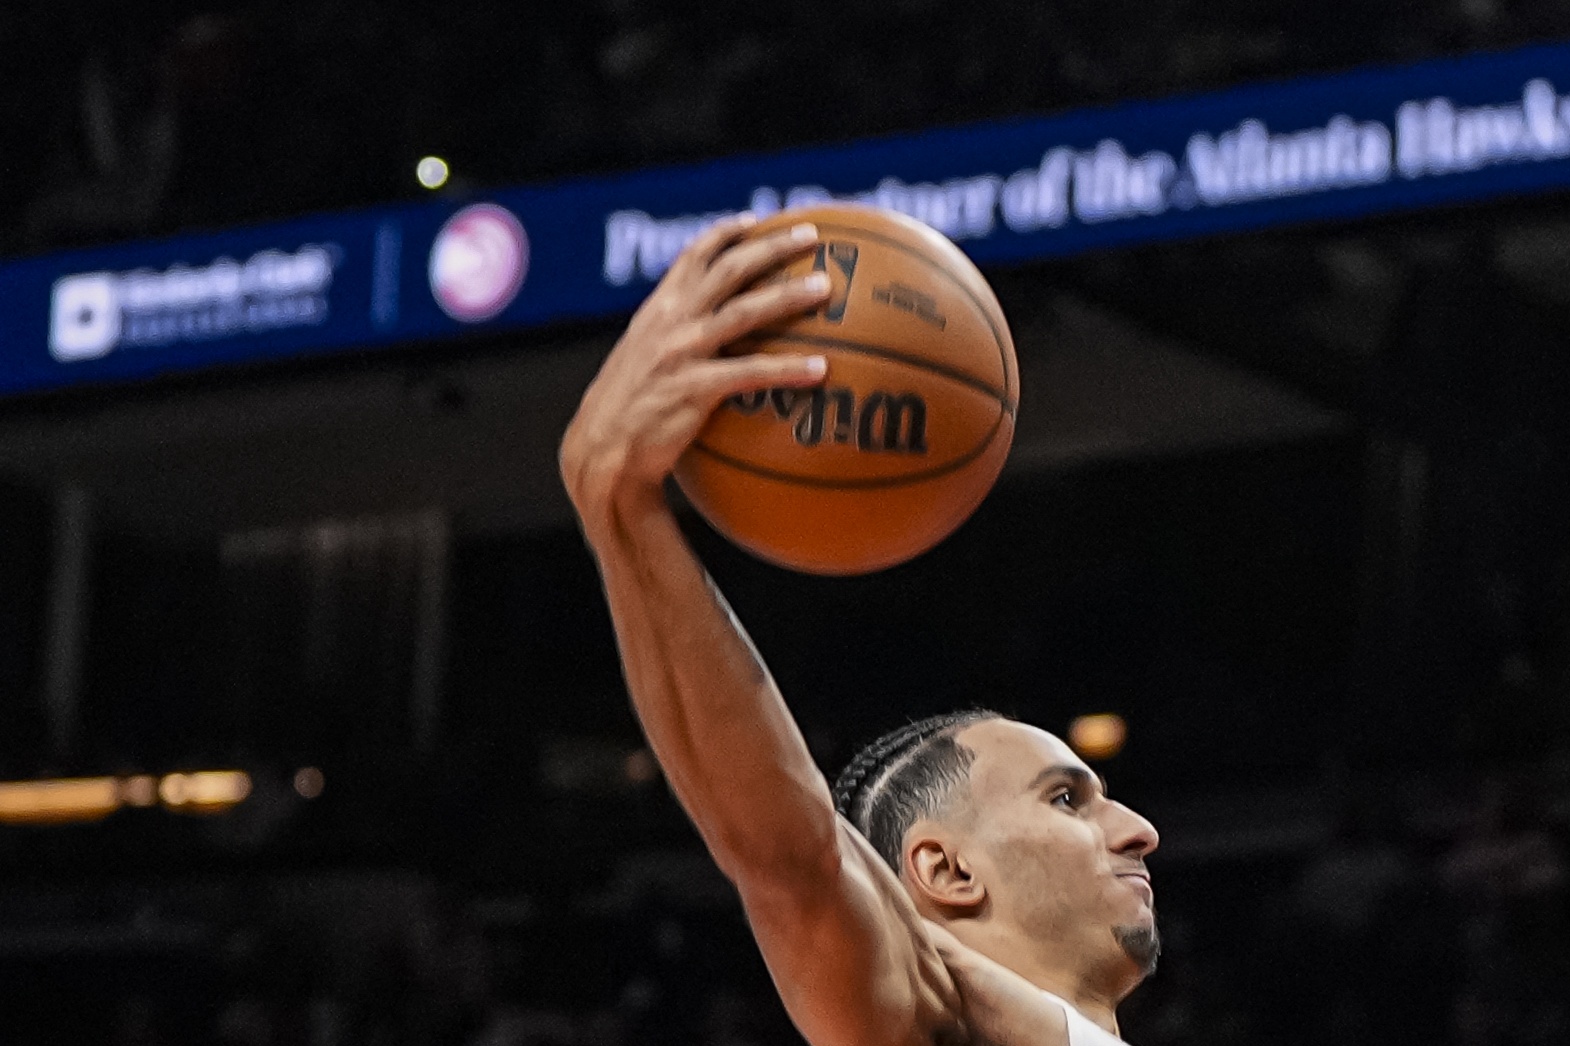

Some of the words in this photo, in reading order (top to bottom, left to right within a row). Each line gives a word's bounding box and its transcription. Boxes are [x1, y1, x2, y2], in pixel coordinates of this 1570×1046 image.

[1002, 148, 1073, 230] of
[1074, 140, 1176, 222] the
[727, 387, 928, 453] Wilso
